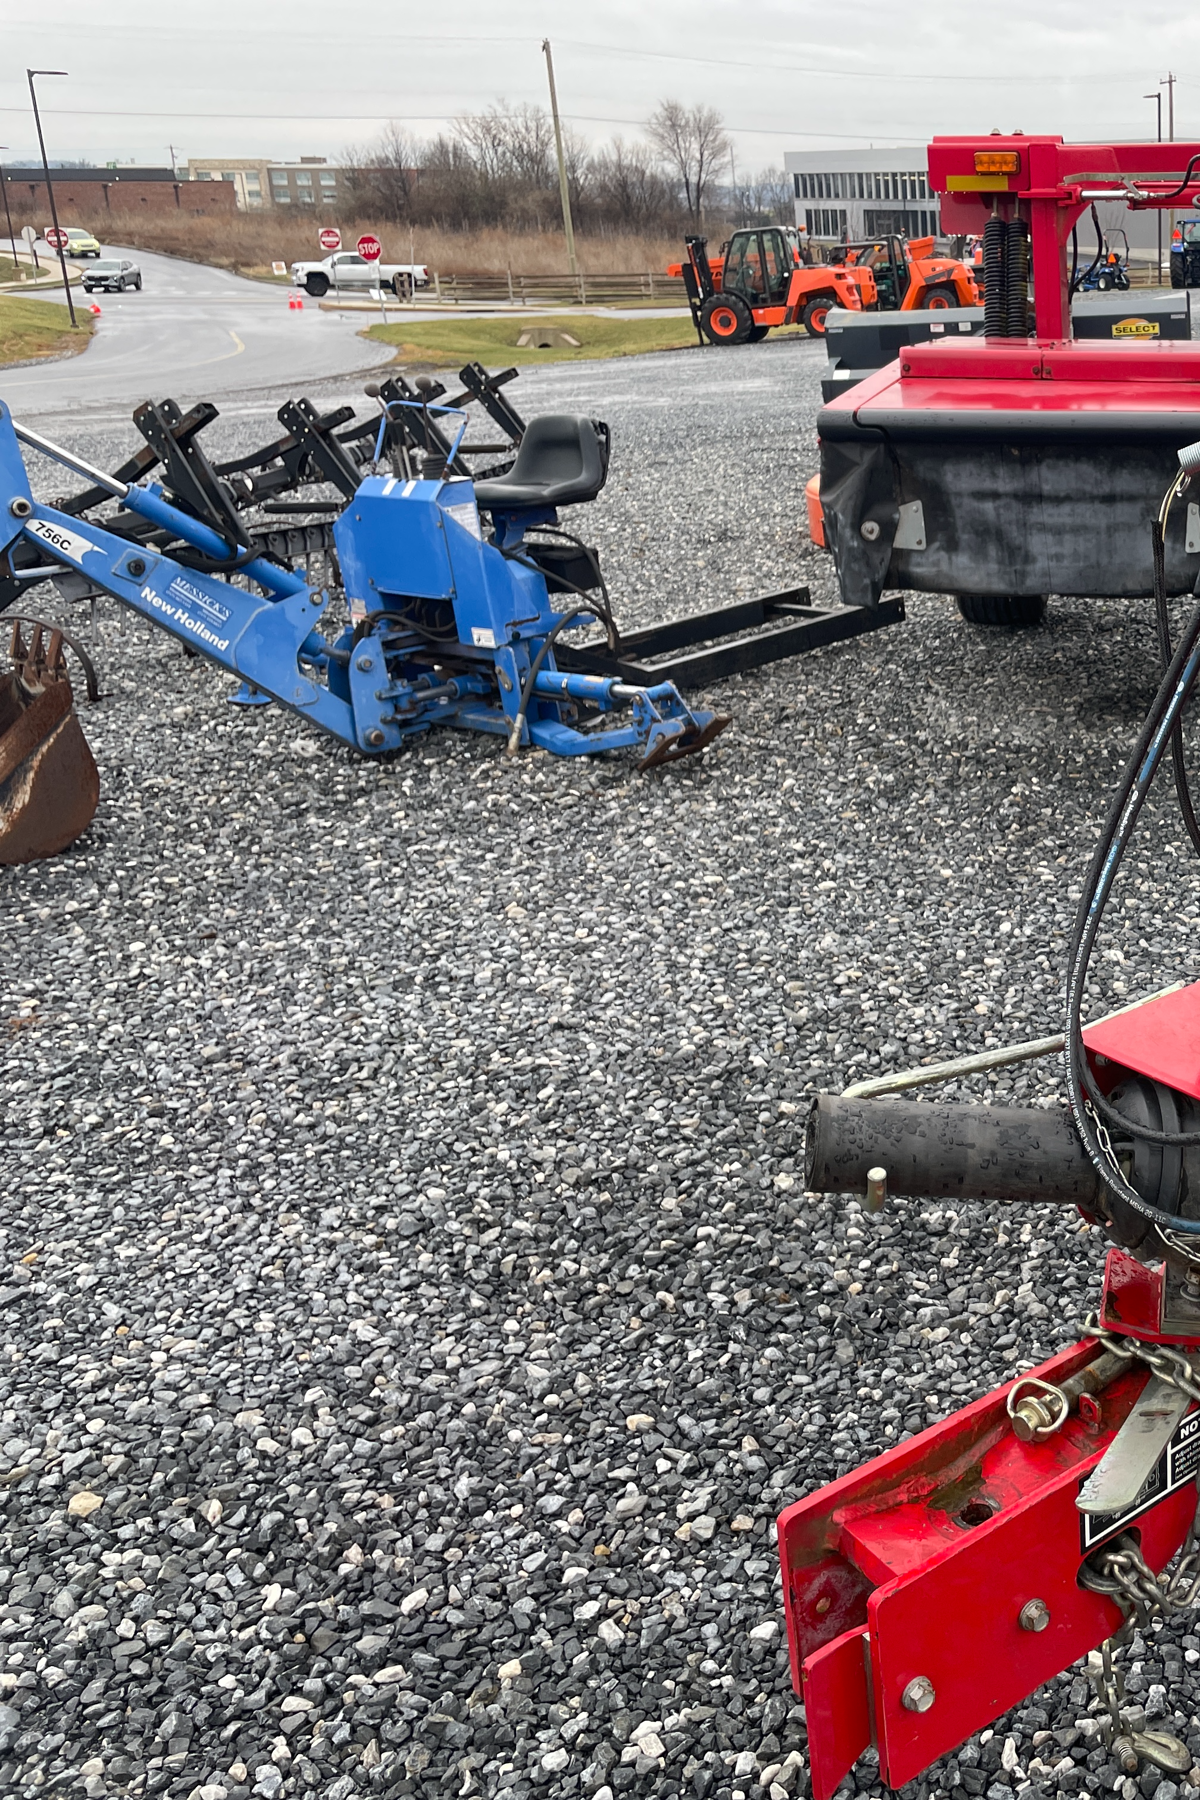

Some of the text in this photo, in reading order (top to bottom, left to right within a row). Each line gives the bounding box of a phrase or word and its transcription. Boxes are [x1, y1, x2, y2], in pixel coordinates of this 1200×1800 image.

[358, 242, 380, 255] STOP
[1114, 324, 1158, 334] SELECT
[34, 521, 72, 551] 756C
[173, 576, 232, 618] MESSICK'S
[140, 585, 176, 616] New
[173, 608, 230, 652] Holland
[1096, 1163, 1110, 1182] Flame
[1107, 1179, 1130, 1203] Resistant
[1128, 1199, 1145, 1214] MSHA
[1174, 1445, 1192, 1460] Adjust
[1174, 1456, 1187, 1467] with
[1174, 1459, 1192, 1474] Adjust
